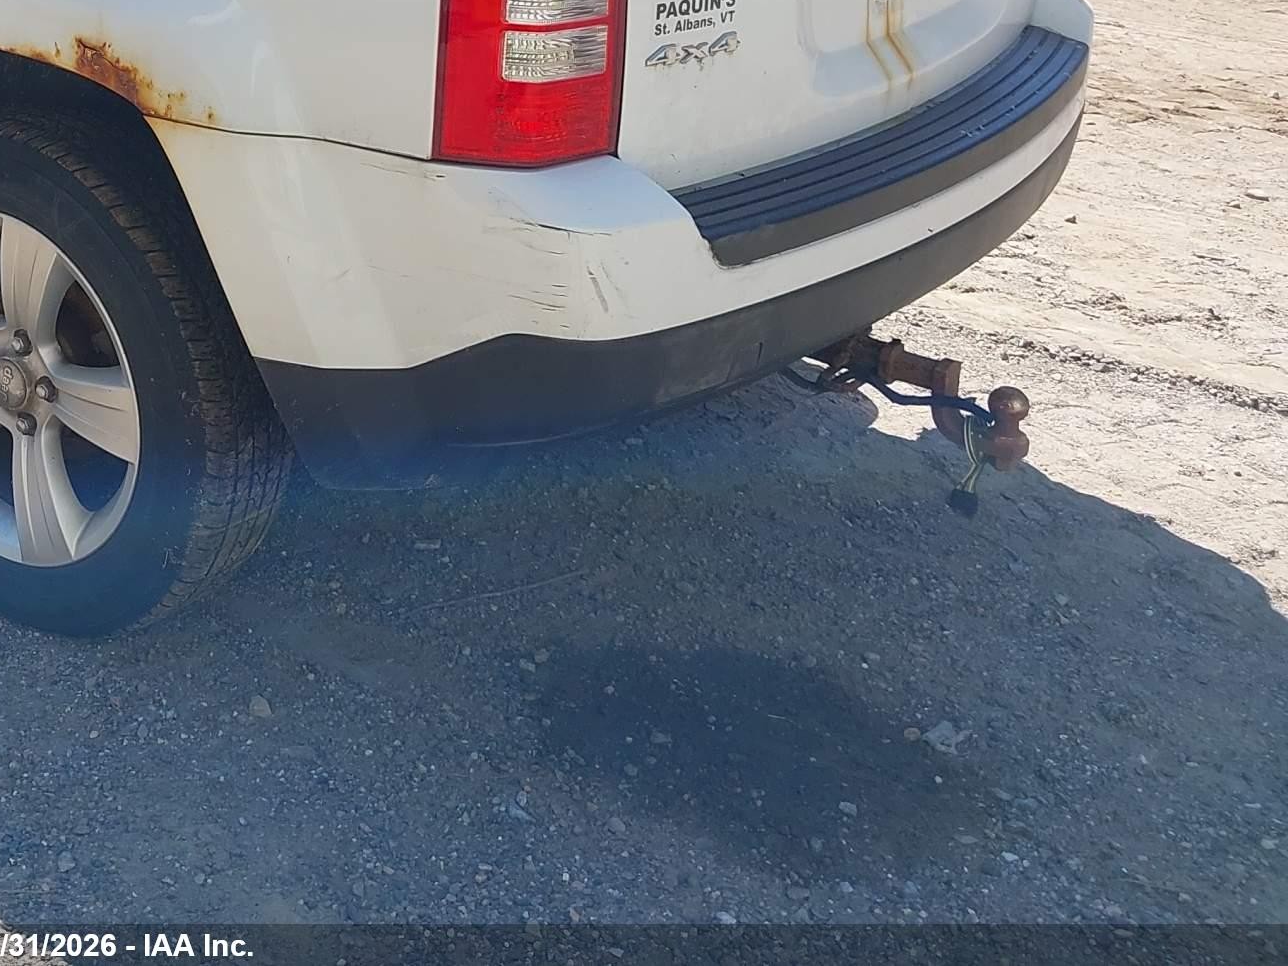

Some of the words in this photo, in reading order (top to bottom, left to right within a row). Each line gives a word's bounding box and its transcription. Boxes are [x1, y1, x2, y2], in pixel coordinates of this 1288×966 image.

[654, 23, 671, 36] St.
[674, 17, 716, 33] Albans,
[720, 10, 736, 23] VT
